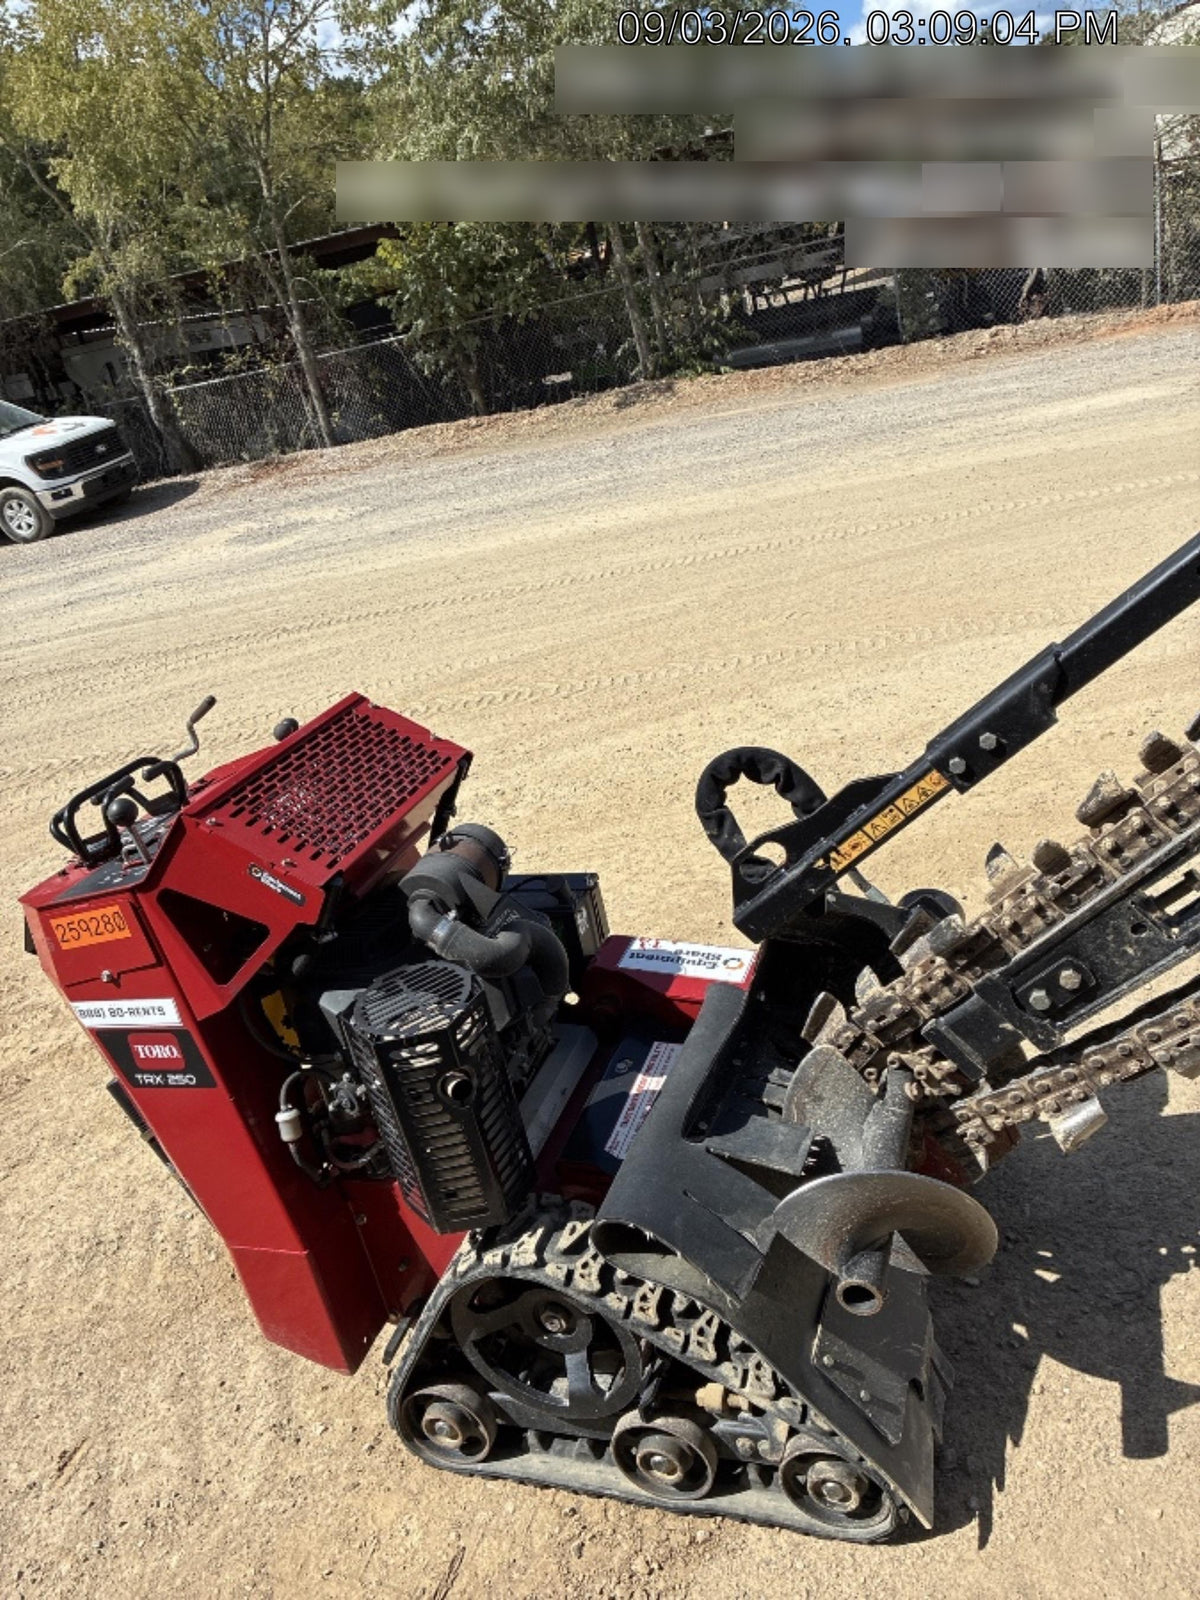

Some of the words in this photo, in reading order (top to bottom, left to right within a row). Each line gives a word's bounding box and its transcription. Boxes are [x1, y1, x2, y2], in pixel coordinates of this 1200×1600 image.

[55, 911, 126, 943] 259280
[134, 1045, 181, 1058] TORO
[134, 1073, 164, 1085] TRX
[167, 1073, 196, 1085] 250
